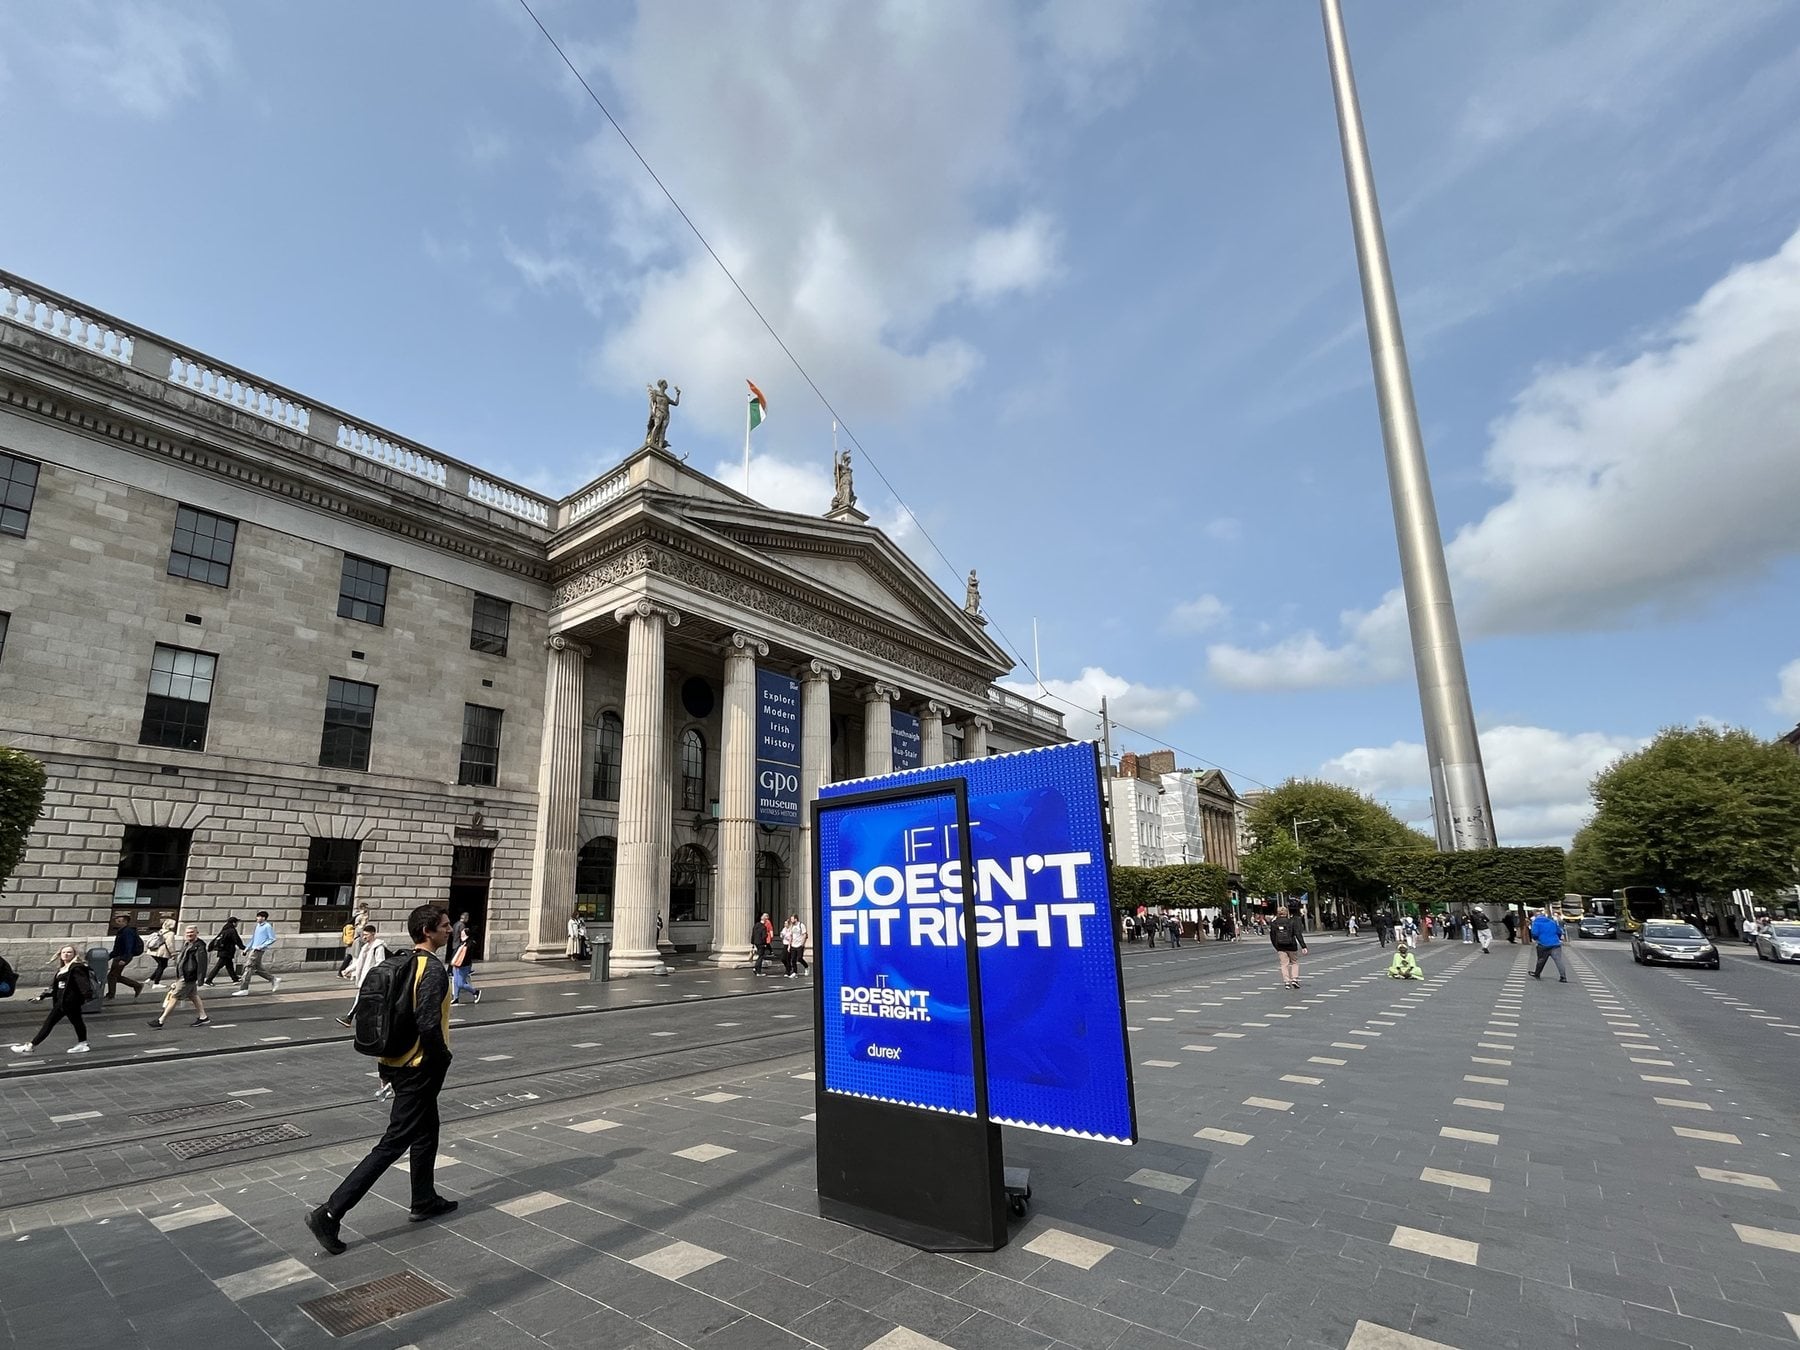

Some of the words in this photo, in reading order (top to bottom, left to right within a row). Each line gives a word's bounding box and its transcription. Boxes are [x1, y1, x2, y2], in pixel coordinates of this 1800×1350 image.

[763, 690, 795, 706] Explore
[763, 705, 796, 721] Modern
[770, 722, 790, 734] Irish
[763, 736, 796, 752] History
[760, 798, 798, 811] museum
[904, 826, 935, 862] IF
[830, 852, 1092, 907] DOESN'T
[830, 908, 901, 946] FIT
[910, 902, 1096, 948] RIGHT
[876, 974, 889, 987] IT
[840, 986, 930, 1008] DOESN'T
[841, 1002, 879, 1017] FEEL
[879, 1005, 931, 1022] RIGHT.
[867, 1043, 901, 1060] durex
